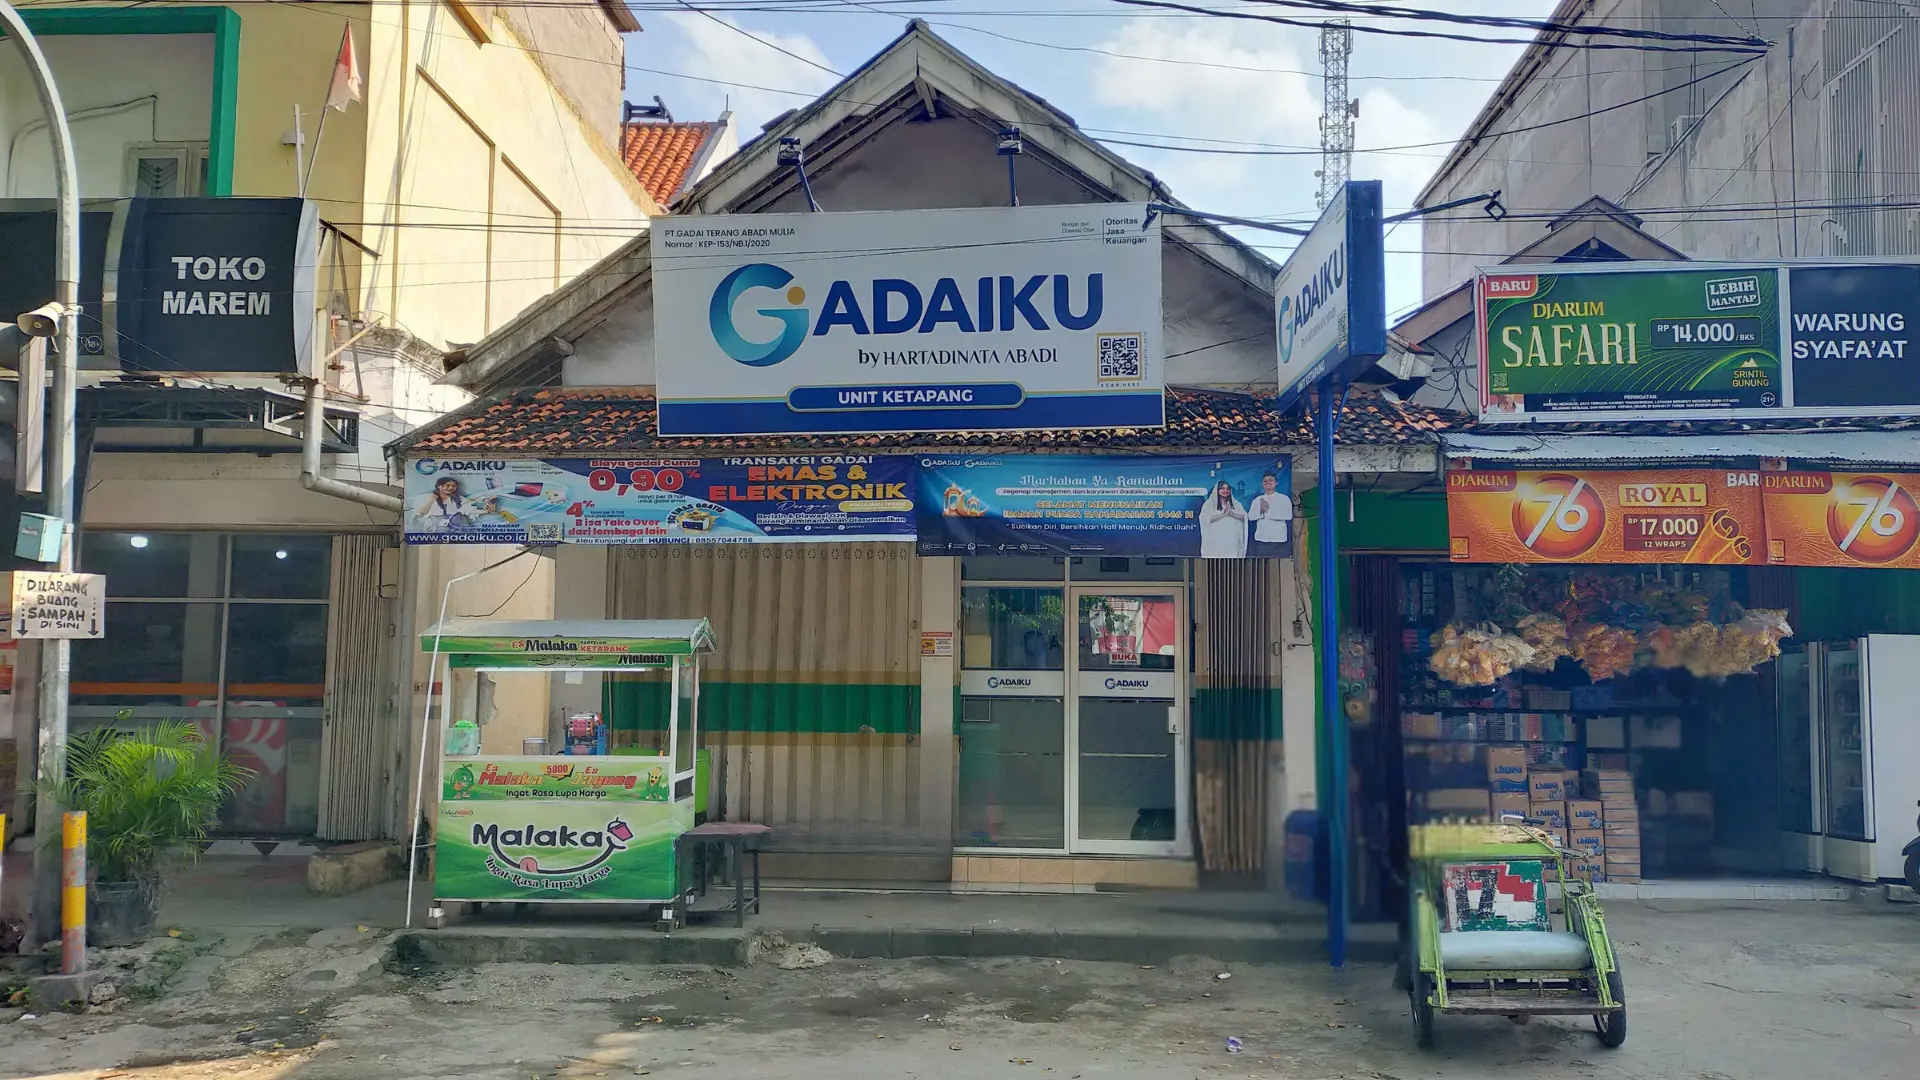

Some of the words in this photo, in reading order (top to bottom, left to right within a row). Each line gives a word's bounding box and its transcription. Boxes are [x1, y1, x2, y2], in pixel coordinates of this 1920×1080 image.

[1105, 218, 1139, 226] Otoritas
[664, 229, 704, 238] PT.GADAI
[706, 229, 740, 237] TERANG
[741, 228, 768, 237] ABADI
[770, 228, 796, 236] MULIA
[664, 240, 694, 249] Nomor
[698, 239, 771, 249] KEP-153/NB.1/2020
[1105, 236, 1147, 245] Keuangan
[171, 256, 266, 281] TOKO
[1490, 280, 1531, 292] BARU
[1709, 280, 1755, 296] LEBIH
[162, 291, 270, 316] MAREM
[1278, 240, 1345, 364] GADAIKU
[1711, 294, 1757, 307] MANTAP
[709, 263, 1103, 366] GADAIKU
[1533, 301, 1605, 320] DJARUM
[1793, 312, 1905, 332] WARUNG
[1672, 323, 1735, 343] 14.000
[1502, 322, 1638, 368] SAFARI
[858, 349, 880, 368] by
[883, 349, 1001, 366] HARTADINATA
[1004, 348, 1058, 364] ABADI
[1733, 371, 1768, 379] SRINTIL
[1732, 378, 1770, 387] GUNUNG
[838, 390, 878, 404] UNIT
[882, 389, 973, 403] KETAPANG
[415, 458, 506, 476] GADAIKU
[591, 460, 625, 468] Biaya
[627, 459, 661, 468] gadai
[662, 459, 699, 467] Cuma
[722, 456, 821, 466] TRANSAKSI
[826, 455, 873, 465] GADAI
[921, 458, 961, 468] GADAIKU
[964, 459, 1003, 468] GADAIKU
[748, 466, 838, 481] EMAS
[846, 465, 868, 480] &
[1726, 472, 1761, 487] BAR
[1019, 475, 1087, 487] Marhaban
[1091, 475, 1109, 487] Ya
[1113, 475, 1184, 487] Ramadhan
[1449, 474, 1509, 487] DJARUM
[1764, 475, 1825, 489] DJARUM
[708, 483, 907, 501] ELEKTRONIK
[1625, 487, 1702, 503] ROYAL
[565, 500, 595, 518] 4%
[775, 500, 834, 512] Dengan
[1035, 501, 1086, 509] SELAMAT
[1088, 501, 1164, 509] MENUNAIKAN
[1003, 510, 1043, 519] IBADAH
[1045, 510, 1081, 519] PUASA
[1157, 510, 1182, 519] 1446
[1184, 510, 1194, 518] H
[1524, 478, 1589, 548] 76
[1839, 481, 1904, 552] 76
[568, 527, 592, 535] dari
[593, 527, 644, 537] lembaga
[645, 527, 667, 535] lain
[1044, 523, 1059, 531] Diri,
[1060, 523, 1099, 531] Bersihkan
[1118, 523, 1148, 531] Menuju
[1640, 517, 1699, 536] 17.000
[408, 533, 528, 544] www.gadaiku.co.id
[1644, 540, 1653, 548] 12
[1654, 540, 1686, 548] WRAPS
[27, 579, 88, 597] DILARANG
[37, 595, 78, 609] BUANG
[27, 607, 85, 622] SAMPAH
[40, 620, 52, 629] DI
[56, 620, 80, 630] SINI
[524, 639, 578, 652] Malaka
[618, 654, 666, 665] Malaka
[987, 676, 1031, 688] GADAIKU
[1104, 677, 1149, 690] GADAIKU
[485, 763, 499, 772] Es
[547, 764, 569, 774] 5000
[585, 766, 599, 774] Es
[478, 771, 544, 785] Malaka
[505, 789, 530, 798] Ingat
[532, 789, 554, 797] Rasa
[556, 789, 577, 798] Lupa
[579, 789, 607, 798] Harga
[472, 823, 604, 848] Malaka
[485, 855, 511, 879] Ingat
[511, 873, 539, 888] Rasa
[541, 878, 574, 890] Lupa
[574, 866, 612, 888] Harga
